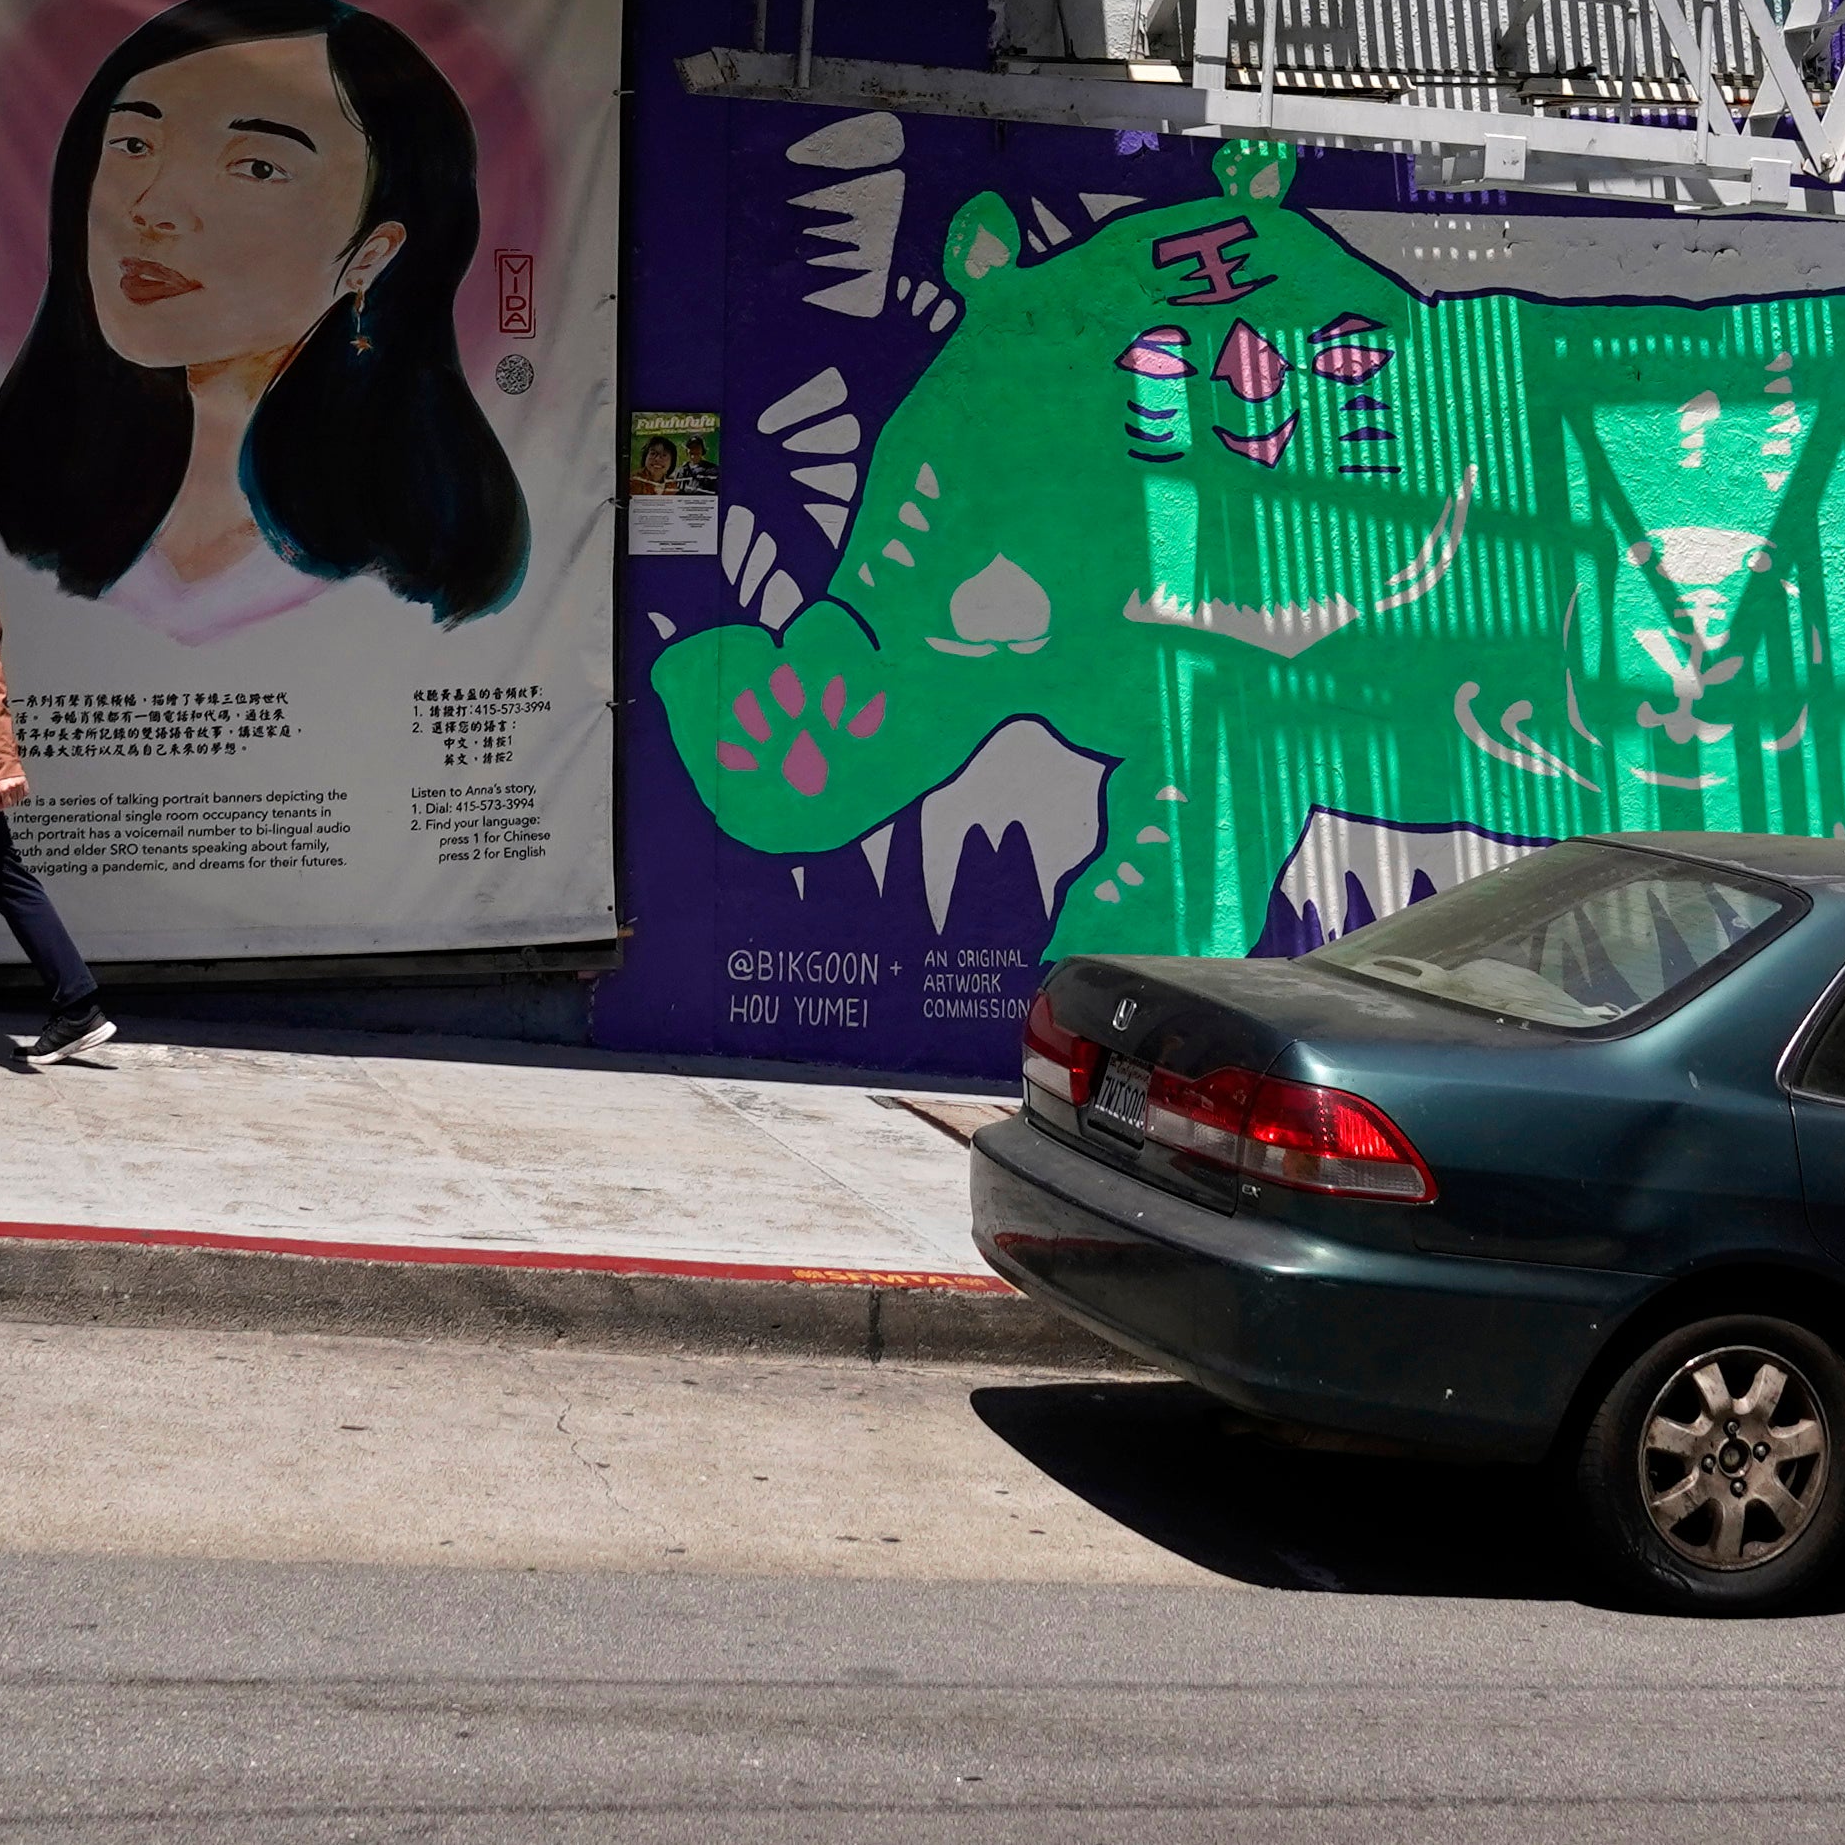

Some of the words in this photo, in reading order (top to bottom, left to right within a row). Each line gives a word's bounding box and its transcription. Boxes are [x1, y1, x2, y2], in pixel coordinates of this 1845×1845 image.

[505, 260, 528, 327] VIDA
[413, 706, 423, 717] 1.
[412, 722, 423, 733] 2.
[36, 796, 45, 806] is
[49, 797, 55, 806] a
[60, 795, 96, 806] series
[100, 793, 114, 804] of
[117, 791, 159, 807] talking
[163, 792, 209, 807] portrait
[214, 791, 263, 803] banners
[266, 790, 324, 804] depicting
[328, 789, 348, 801] the
[411, 787, 446, 798] Listen
[450, 788, 462, 797] to
[465, 783, 502, 796] Anna's
[505, 784, 536, 796] story,
[412, 804, 421, 814] 1.
[426, 803, 452, 814] Dial:
[456, 798, 534, 812] 415-573-3994
[13, 810, 122, 826] intergenerational
[125, 810, 162, 825] single
[166, 812, 199, 821] room
[203, 810, 268, 821] occupancy
[272, 808, 317, 818] tenants
[321, 807, 331, 817] in
[411, 820, 421, 830] 2.
[426, 818, 451, 830] Find
[454, 818, 480, 832] your
[483, 816, 541, 829] language:
[38, 829, 85, 842] portrait
[89, 828, 111, 839] has
[114, 830, 121, 838] a
[125, 828, 184, 839] voicemail
[188, 827, 236, 837] number
[240, 826, 252, 836] to
[256, 823, 313, 837] bi-lingual
[317, 822, 351, 834] audio
[440, 835, 469, 848] press
[474, 833, 479, 843] 1
[484, 832, 500, 843] for
[504, 831, 551, 842] Chinese
[46, 845, 70, 856] and
[74, 844, 107, 855] elder
[110, 843, 139, 855] SRO
[142, 843, 188, 854] tenants
[192, 842, 247, 855] speaking
[251, 841, 288, 852] about
[291, 839, 329, 852] family,
[439, 851, 469, 864] press
[473, 849, 480, 859] 2
[484, 848, 500, 859] for
[504, 846, 546, 860] English
[23, 862, 88, 875] navigating
[91, 863, 99, 872] a
[102, 860, 168, 876] pandemic,
[172, 859, 196, 870] and
[200, 858, 245, 870] dreams
[248, 857, 267, 869] for
[270, 856, 299, 868] their
[302, 855, 347, 867] futures.
[924, 950, 948, 968] AN
[957, 949, 1028, 968] ORIGINAL
[727, 950, 880, 986] @BIKGOON
[924, 974, 1002, 994] ARTWORK
[729, 995, 780, 1024] HOU
[793, 997, 869, 1028] YUMEI
[924, 999, 1031, 1019] COMMISSION
[823, 1269, 956, 1286] SFMTA
